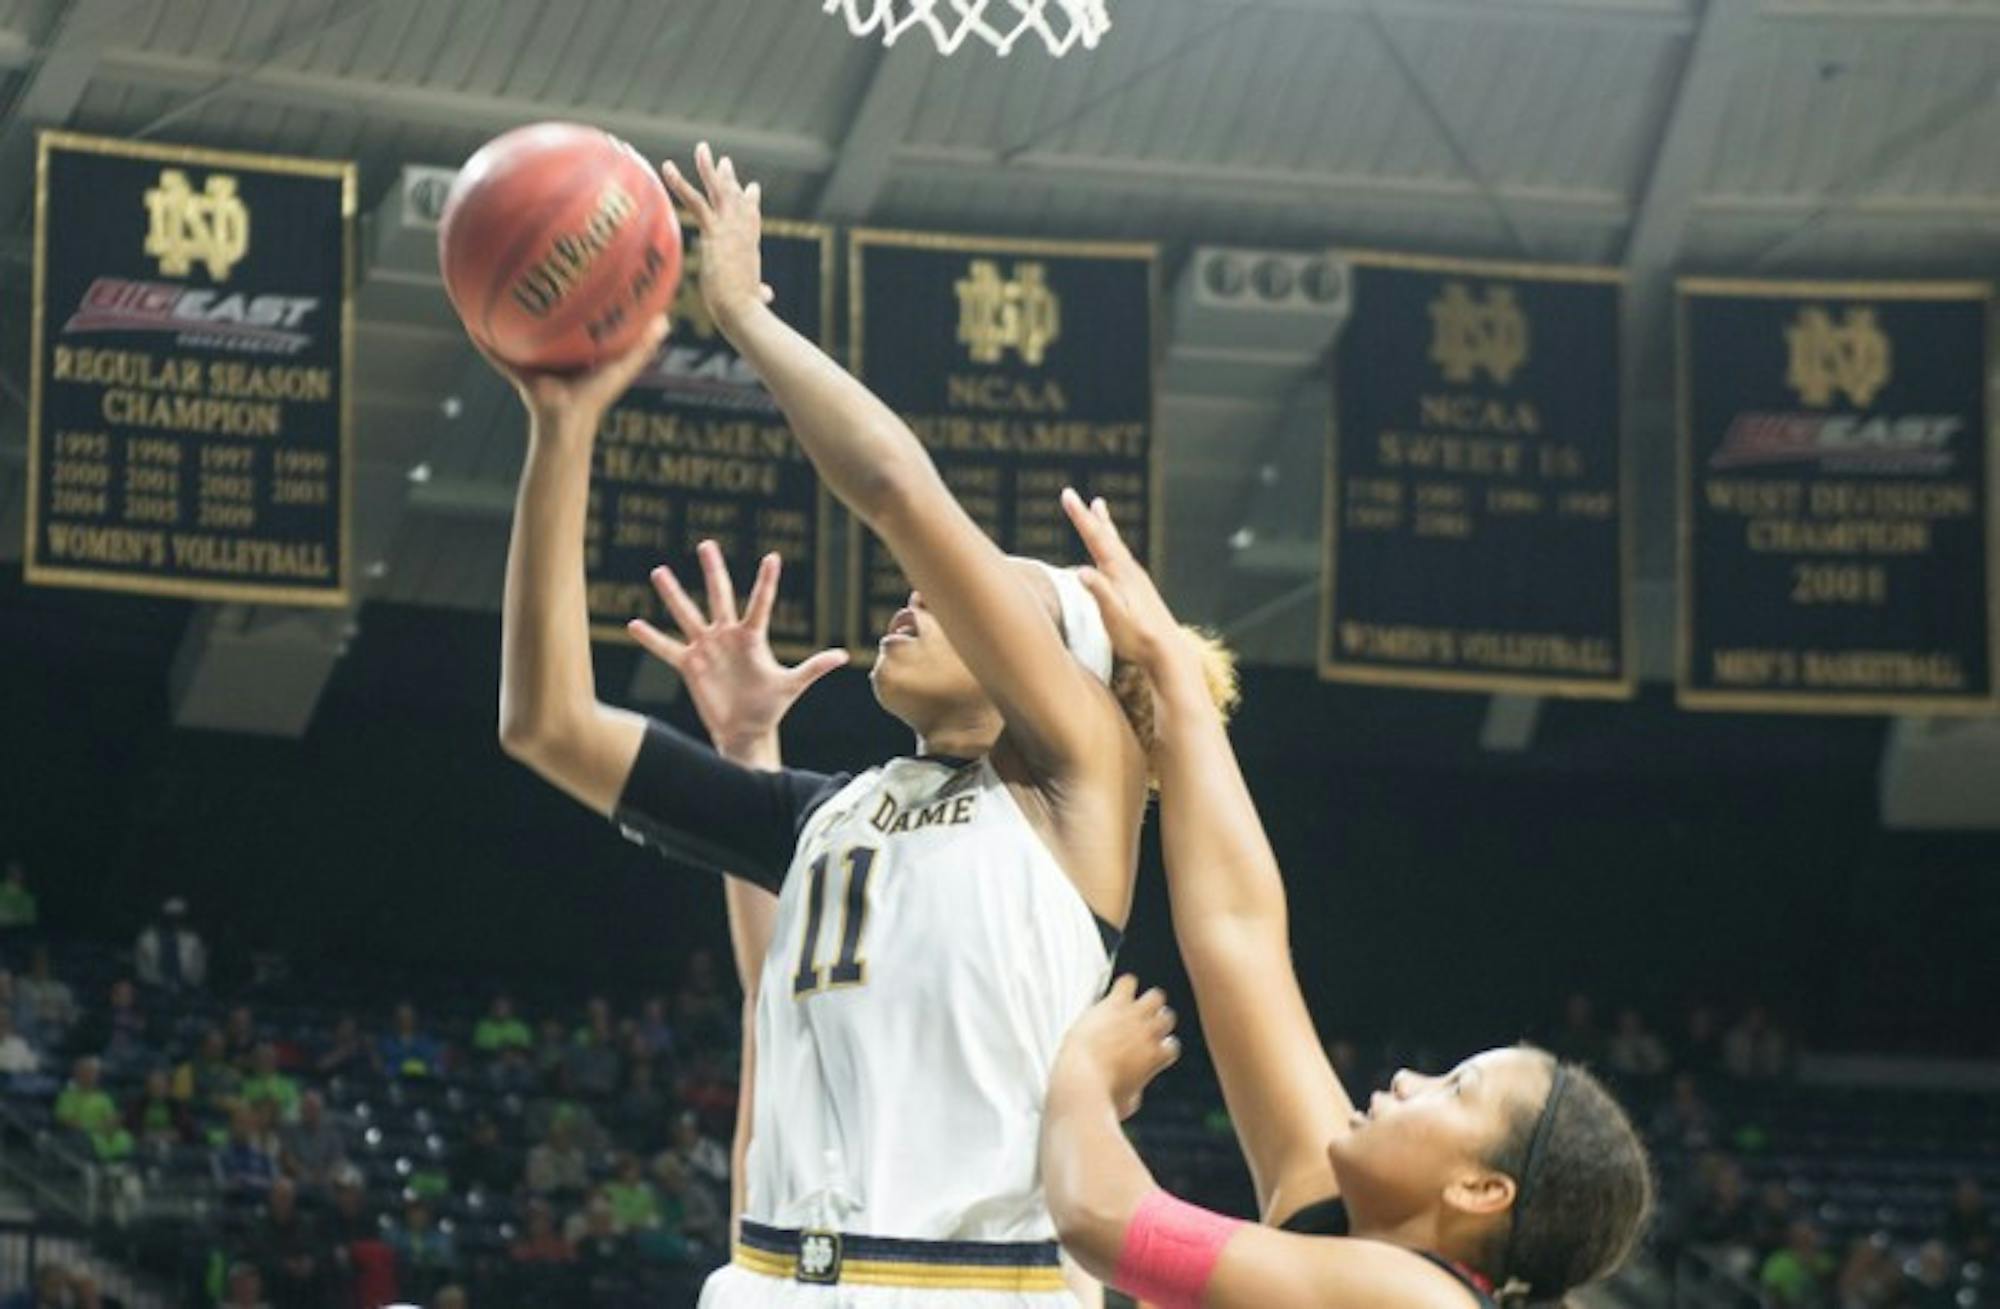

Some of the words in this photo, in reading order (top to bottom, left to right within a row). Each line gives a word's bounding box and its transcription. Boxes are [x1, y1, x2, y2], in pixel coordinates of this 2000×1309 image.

[511, 183, 637, 319] Wilson
[53, 345, 200, 390] REGULAR
[209, 361, 331, 400] SEASON
[947, 374, 1066, 411] NCAA
[102, 389, 280, 436] CHAMPION
[1420, 395, 1539, 433] NCAA
[1704, 480, 1801, 515] WEST
[1810, 481, 1971, 517] DIVISION
[48, 522, 166, 568] WOMEN'S
[172, 534, 329, 577] VOLLEYBALL
[1748, 518, 1930, 554] CHAMPION
[1790, 562, 1888, 606] 2001
[870, 791, 976, 835] DAME
[792, 843, 880, 1002] 11
